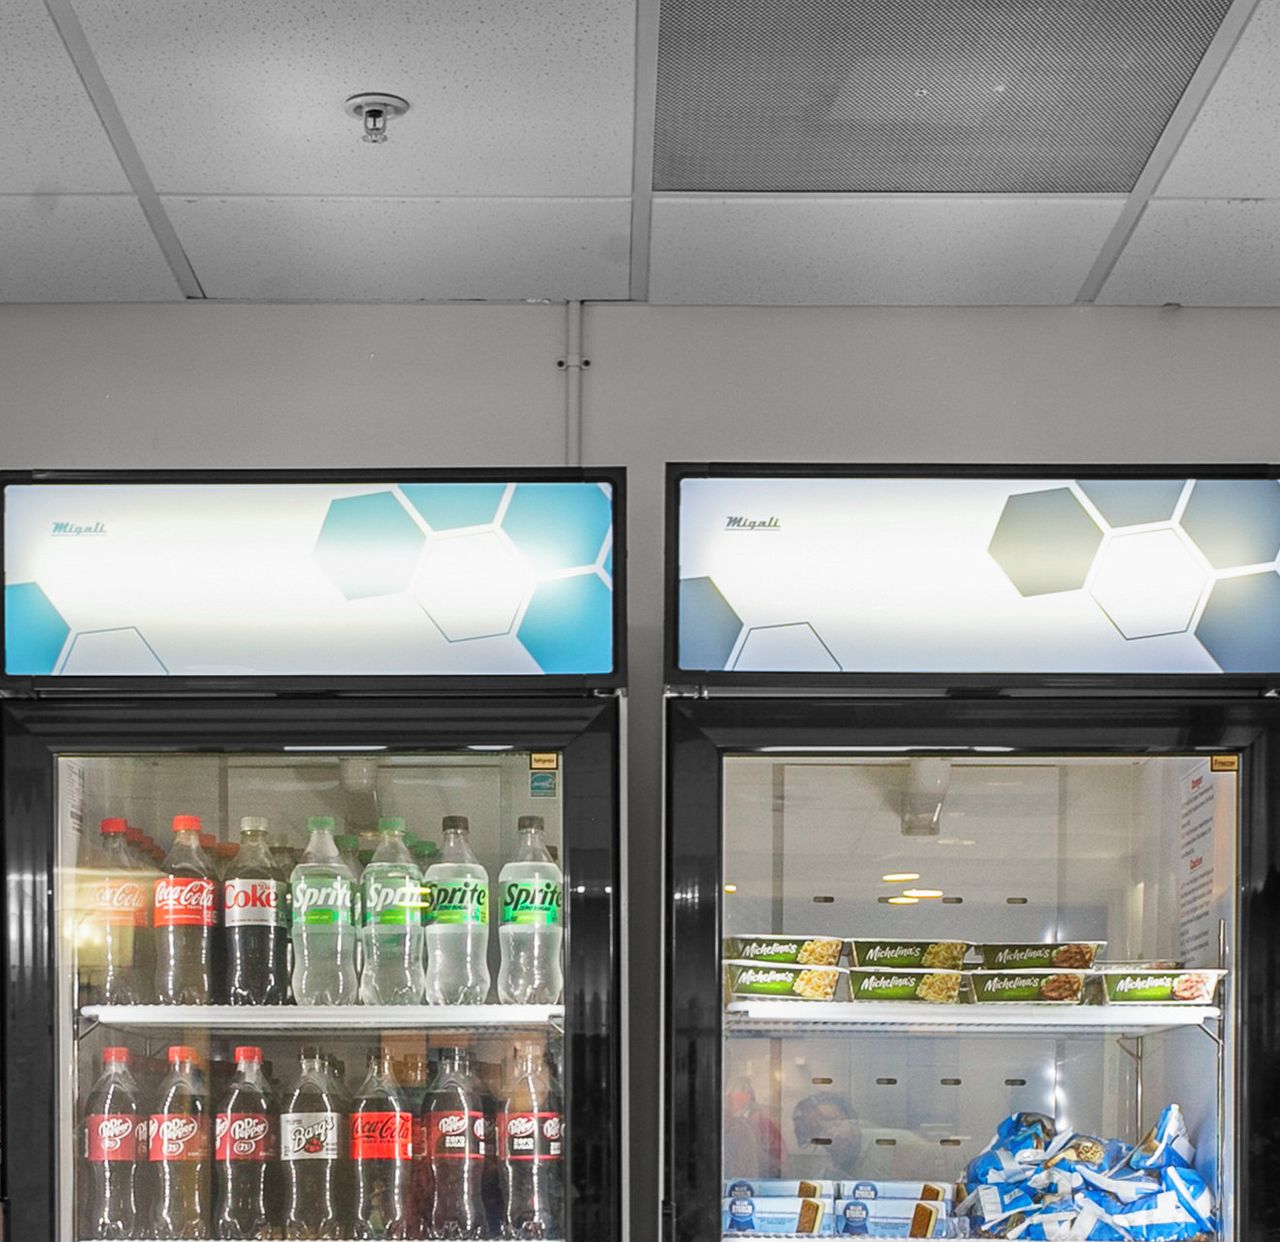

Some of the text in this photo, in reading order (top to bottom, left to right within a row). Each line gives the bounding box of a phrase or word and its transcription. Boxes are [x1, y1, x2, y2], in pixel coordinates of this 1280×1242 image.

[725, 515, 781, 531] Migali
[155, 880, 214, 907] Coca-Cola
[225, 883, 278, 911] Coke
[742, 942, 798, 958] Michelina's
[866, 945, 921, 961] Michelina's
[996, 948, 1051, 964] Michelina's
[738, 969, 794, 985] Michelina's
[861, 975, 916, 991] Michelina's
[984, 976, 1040, 992] Michelina's
[1116, 976, 1171, 992] Michelina's
[231, 1120, 265, 1140] Pepper
